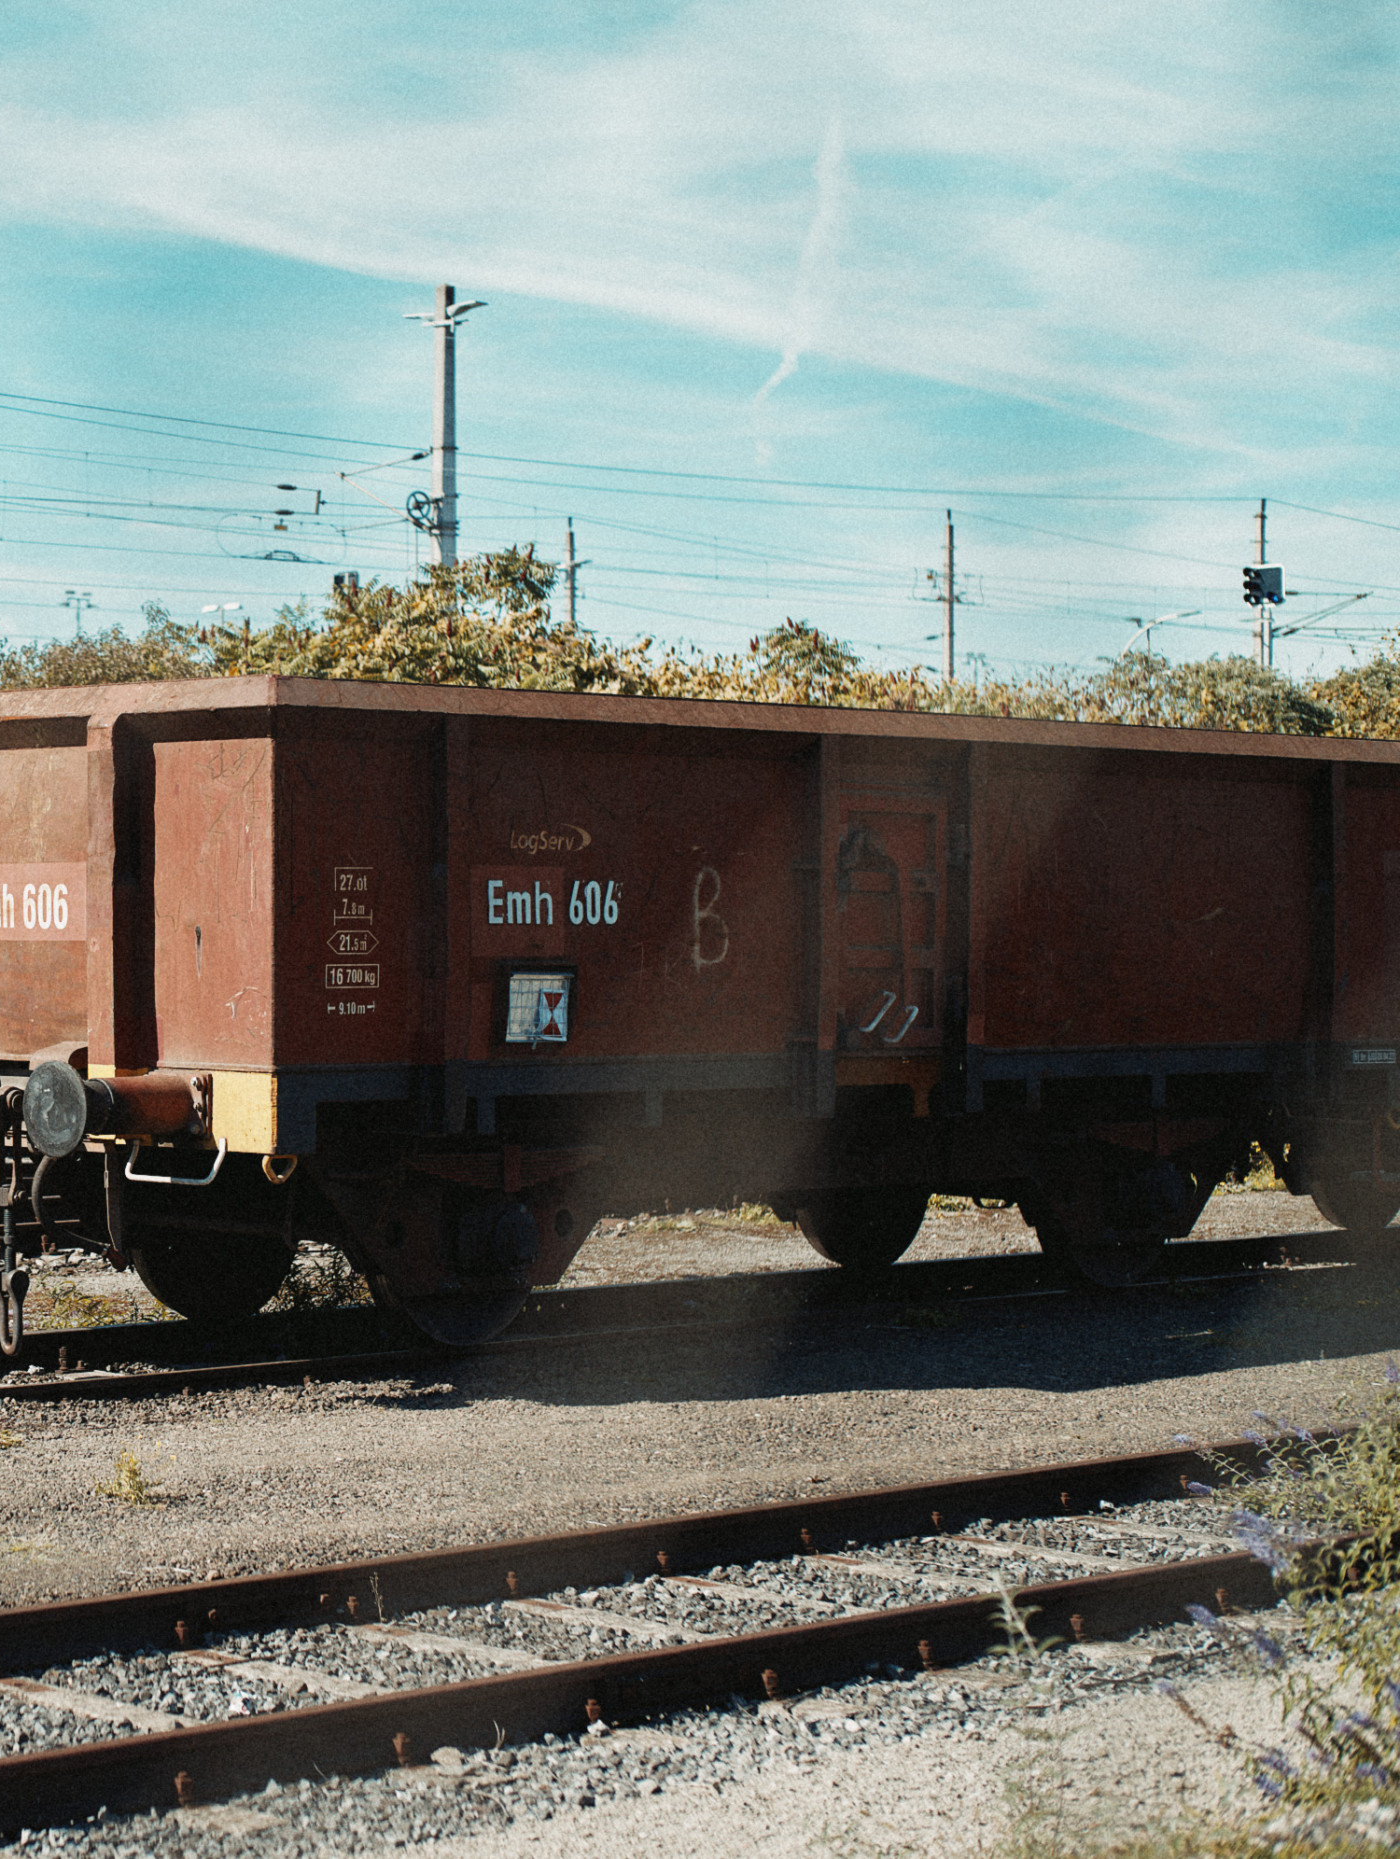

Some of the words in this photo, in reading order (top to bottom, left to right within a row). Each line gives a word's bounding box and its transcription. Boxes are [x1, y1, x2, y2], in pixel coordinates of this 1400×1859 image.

[510, 830, 575, 855] LogServ
[23, 883, 68, 930] 606
[488, 879, 553, 925] Emh
[569, 880, 618, 925] 606
[364, 970, 376, 986] kg
